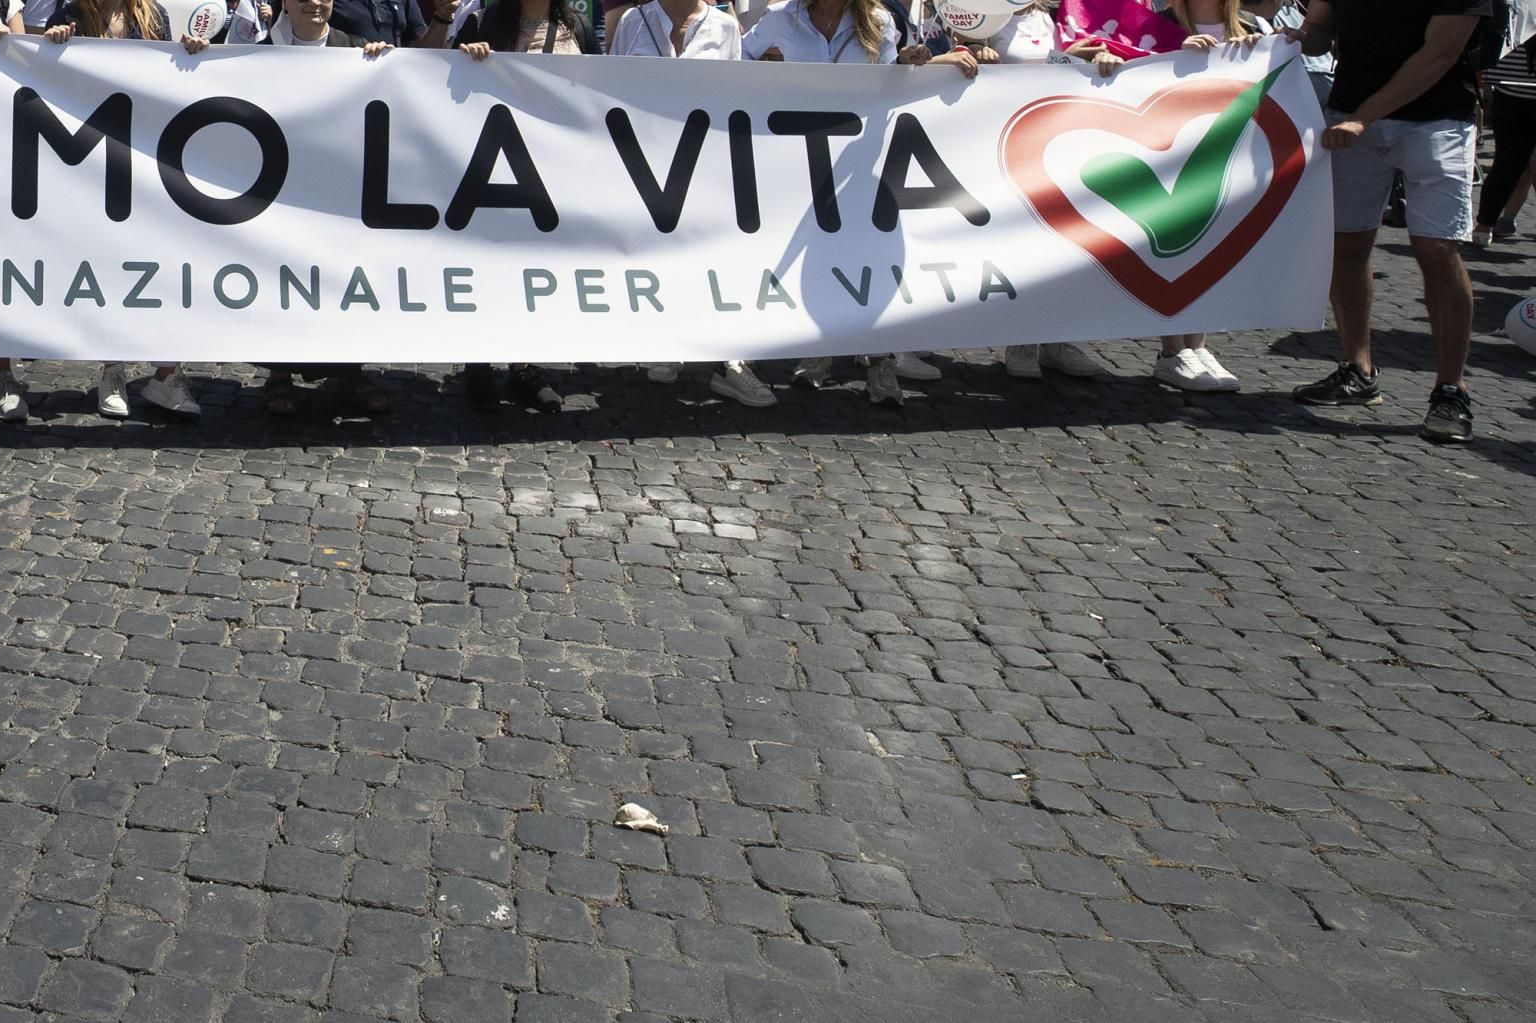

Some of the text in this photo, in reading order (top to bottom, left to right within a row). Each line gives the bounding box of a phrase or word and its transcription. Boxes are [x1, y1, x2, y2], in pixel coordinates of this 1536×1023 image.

[193, 14, 204, 33] DAY
[197, 8, 211, 38] FAMILY
[944, 12, 979, 21] FAMILY
[361, 99, 560, 233] LA
[606, 108, 992, 234] VITA
[2, 259, 478, 313] NAZIONALE
[523, 268, 665, 313] PER
[708, 268, 797, 312] LA
[832, 260, 1018, 307] VITA
